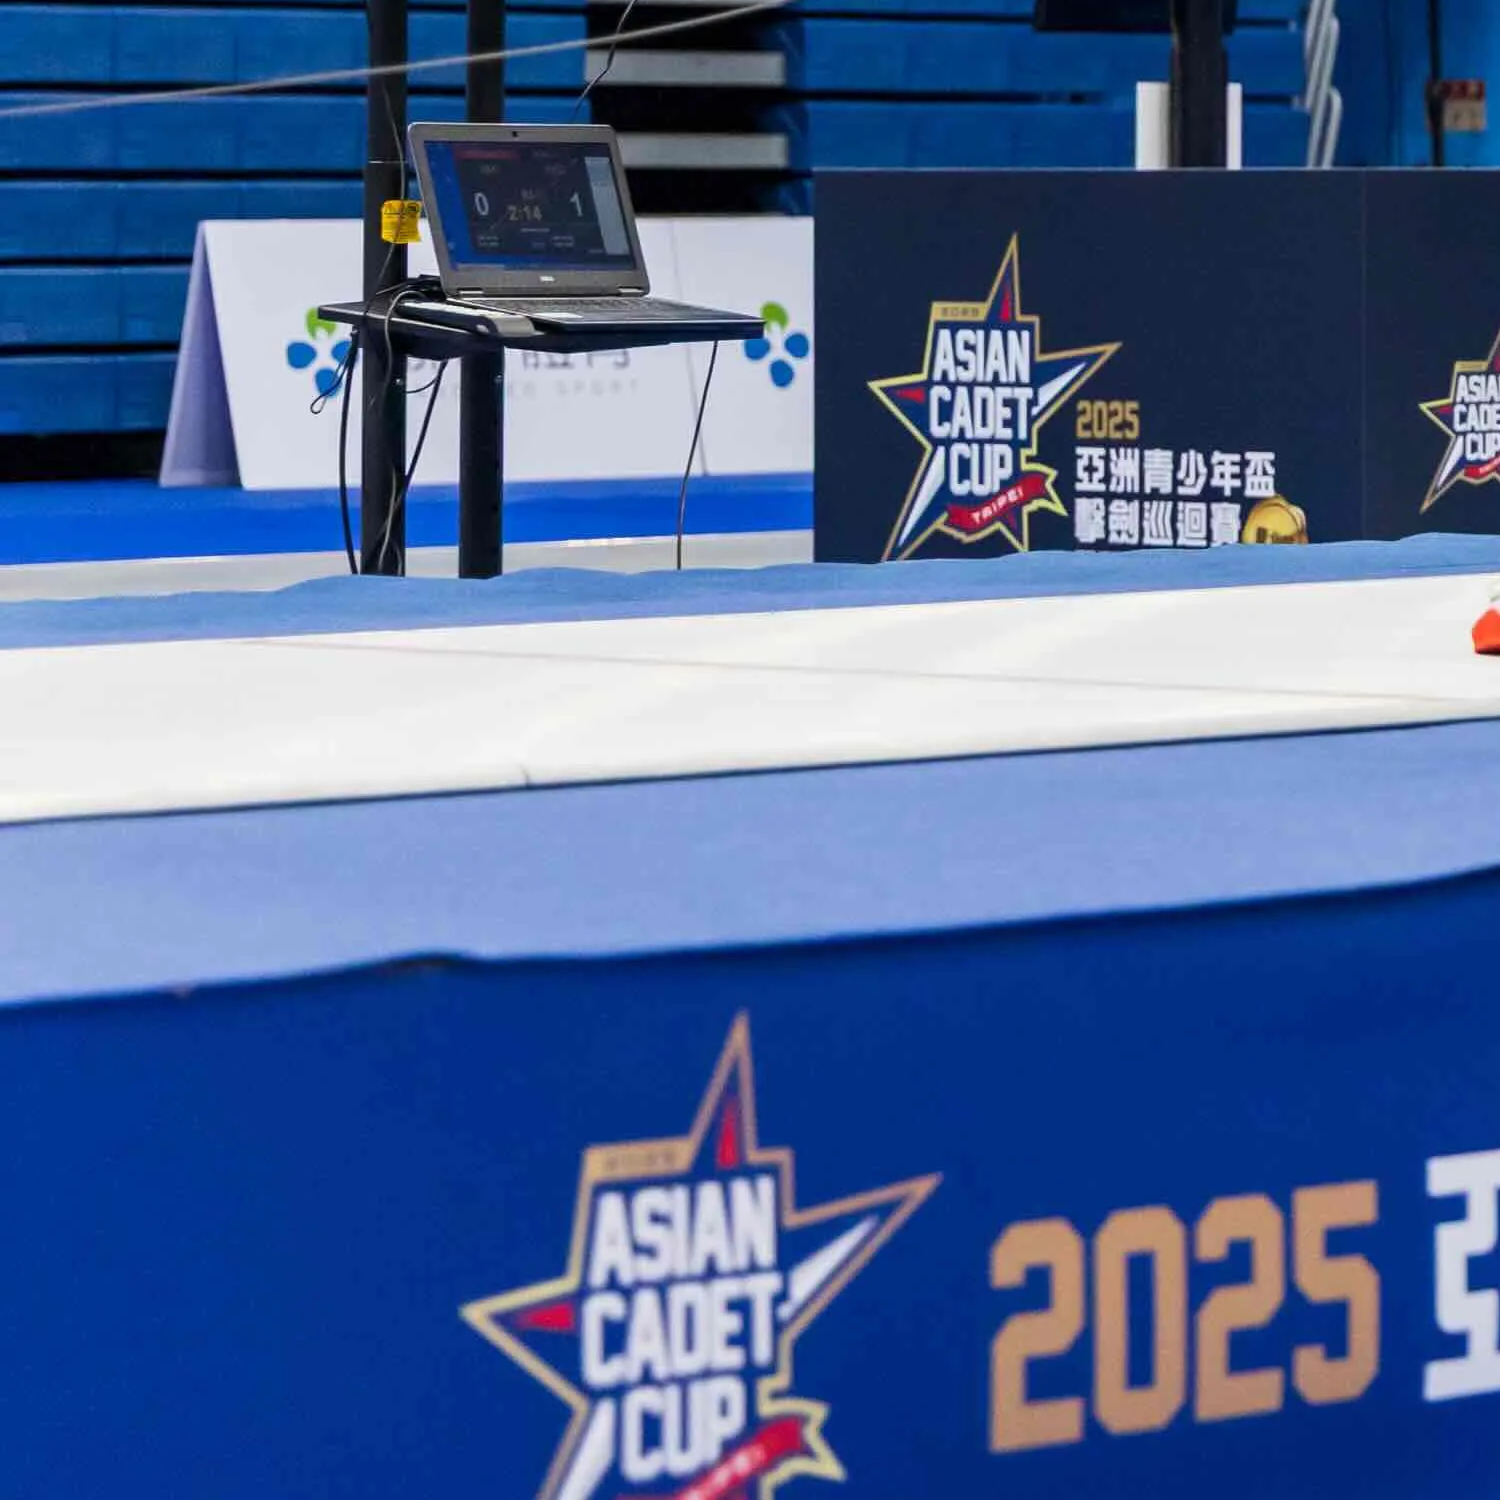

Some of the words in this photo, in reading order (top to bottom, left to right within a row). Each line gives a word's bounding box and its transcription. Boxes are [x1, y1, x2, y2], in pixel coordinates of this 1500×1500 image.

[507, 203, 543, 222] 2:14
[932, 328, 1031, 384] ASIAN
[929, 384, 1034, 441] CADET
[1075, 400, 1140, 440] 2025
[949, 443, 1013, 497] CUP
[1074, 446, 1276, 498] 亞洲青少年盃
[587, 1174, 778, 1289] ASIAN
[578, 1271, 784, 1391] CADET
[989, 1179, 1381, 1453] 2025
[620, 1374, 748, 1483] CUP
